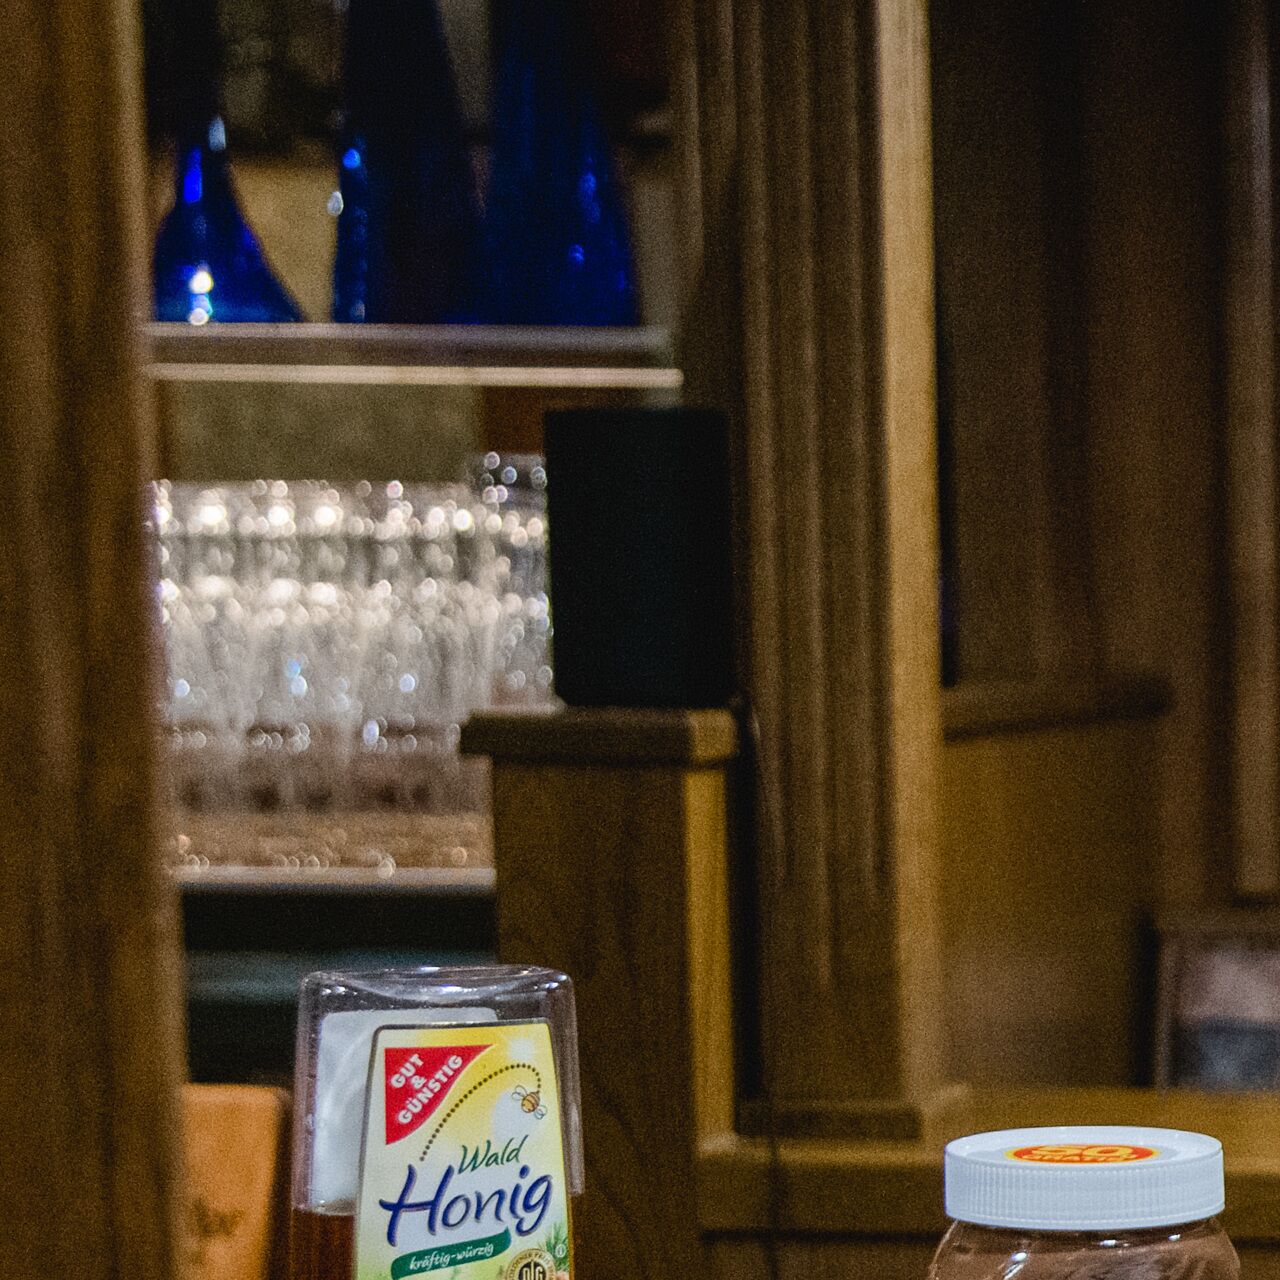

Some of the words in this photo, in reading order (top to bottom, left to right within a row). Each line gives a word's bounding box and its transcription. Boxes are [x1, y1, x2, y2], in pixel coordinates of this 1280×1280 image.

[390, 1053, 424, 1088] GUT
[410, 1075, 427, 1090] &
[398, 1055, 463, 1125] GÜNSTIG
[456, 1135, 529, 1175] Wald
[378, 1164, 553, 1247] Honig
[409, 1242, 494, 1271] kräftig-würzig
